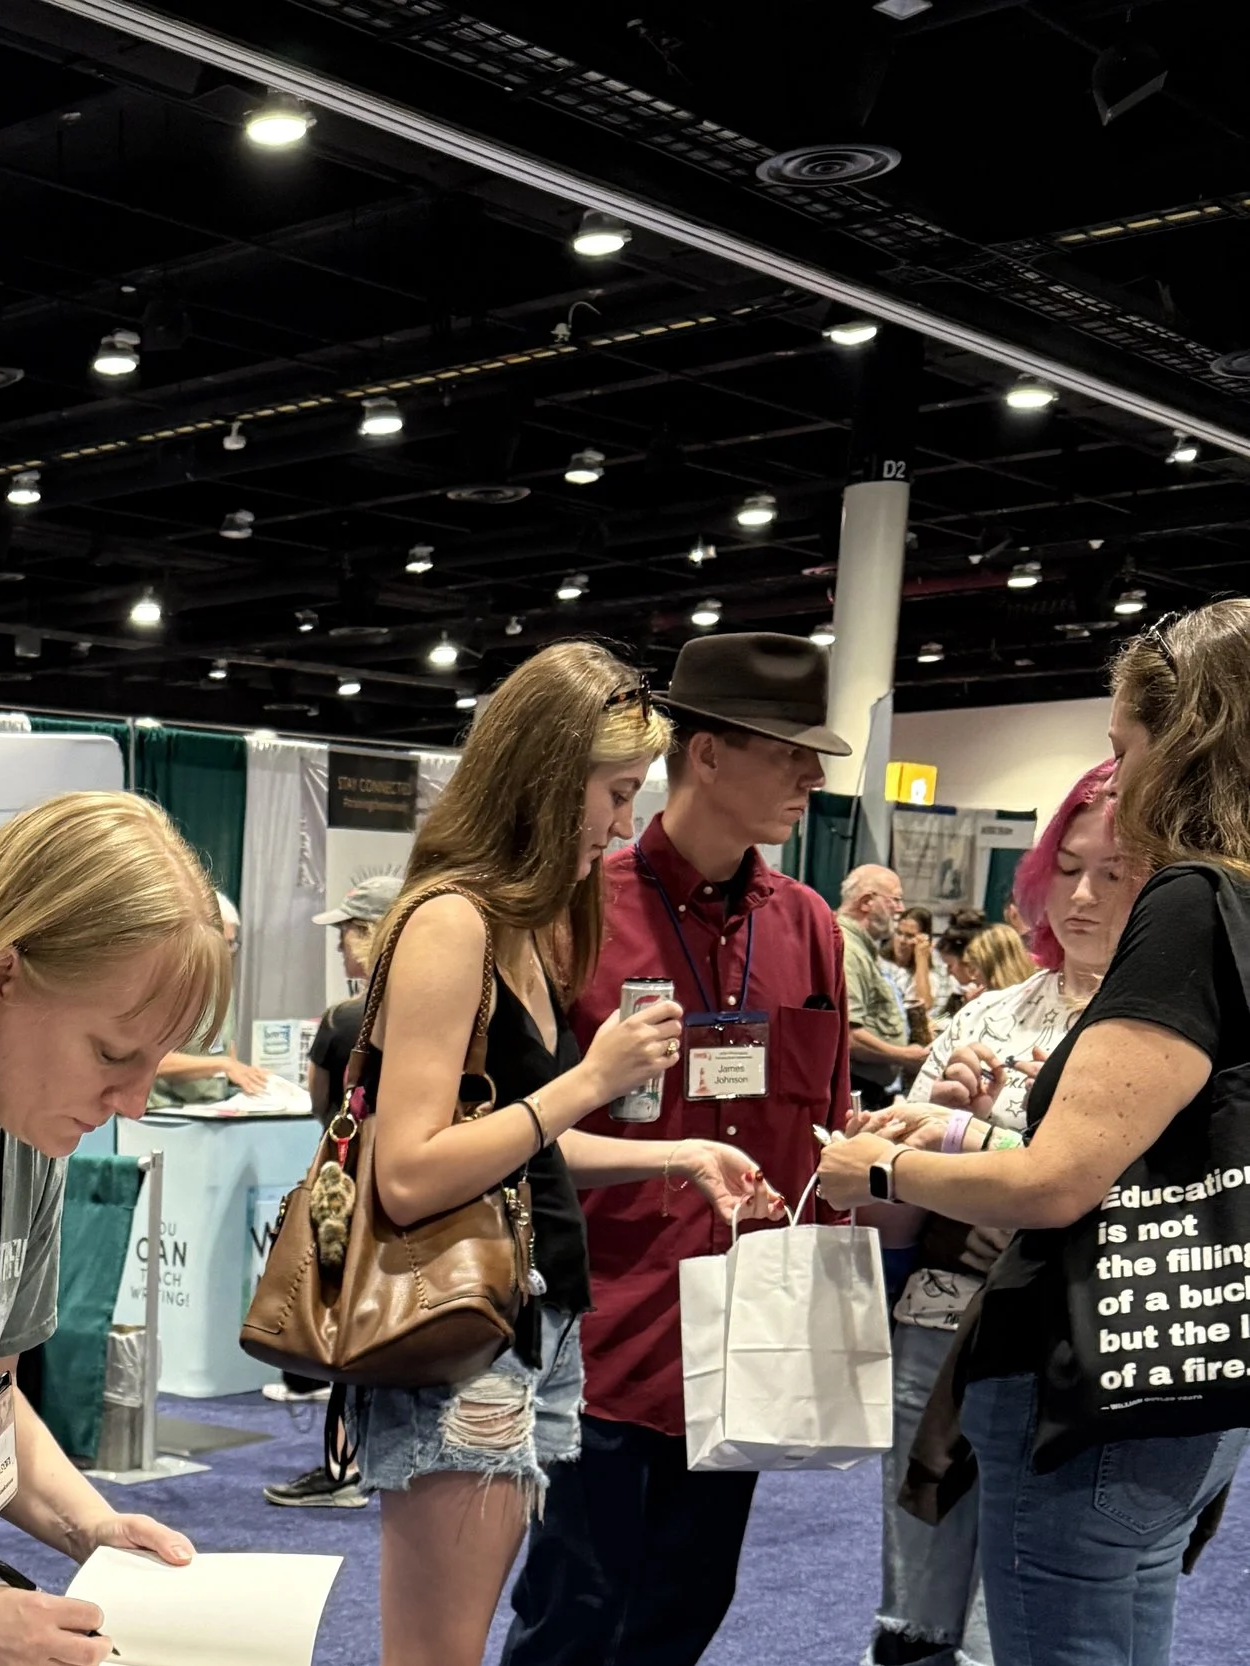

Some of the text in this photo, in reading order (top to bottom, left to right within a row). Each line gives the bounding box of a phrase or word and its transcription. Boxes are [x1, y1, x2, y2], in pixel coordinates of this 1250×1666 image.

[882, 459, 907, 481] D2
[714, 1076, 748, 1085] Johnson
[718, 1064, 745, 1074] James
[1097, 1214, 1199, 1246] is not
[136, 1236, 187, 1268] CAN
[140, 1268, 182, 1287] TCH
[1096, 1254, 1157, 1280] the
[130, 1285, 190, 1307] WRING!
[1098, 1275, 1250, 1317] of a buc
[1100, 1324, 1159, 1354] but
[1168, 1320, 1231, 1348] the
[1100, 1356, 1250, 1391] of a fire.
